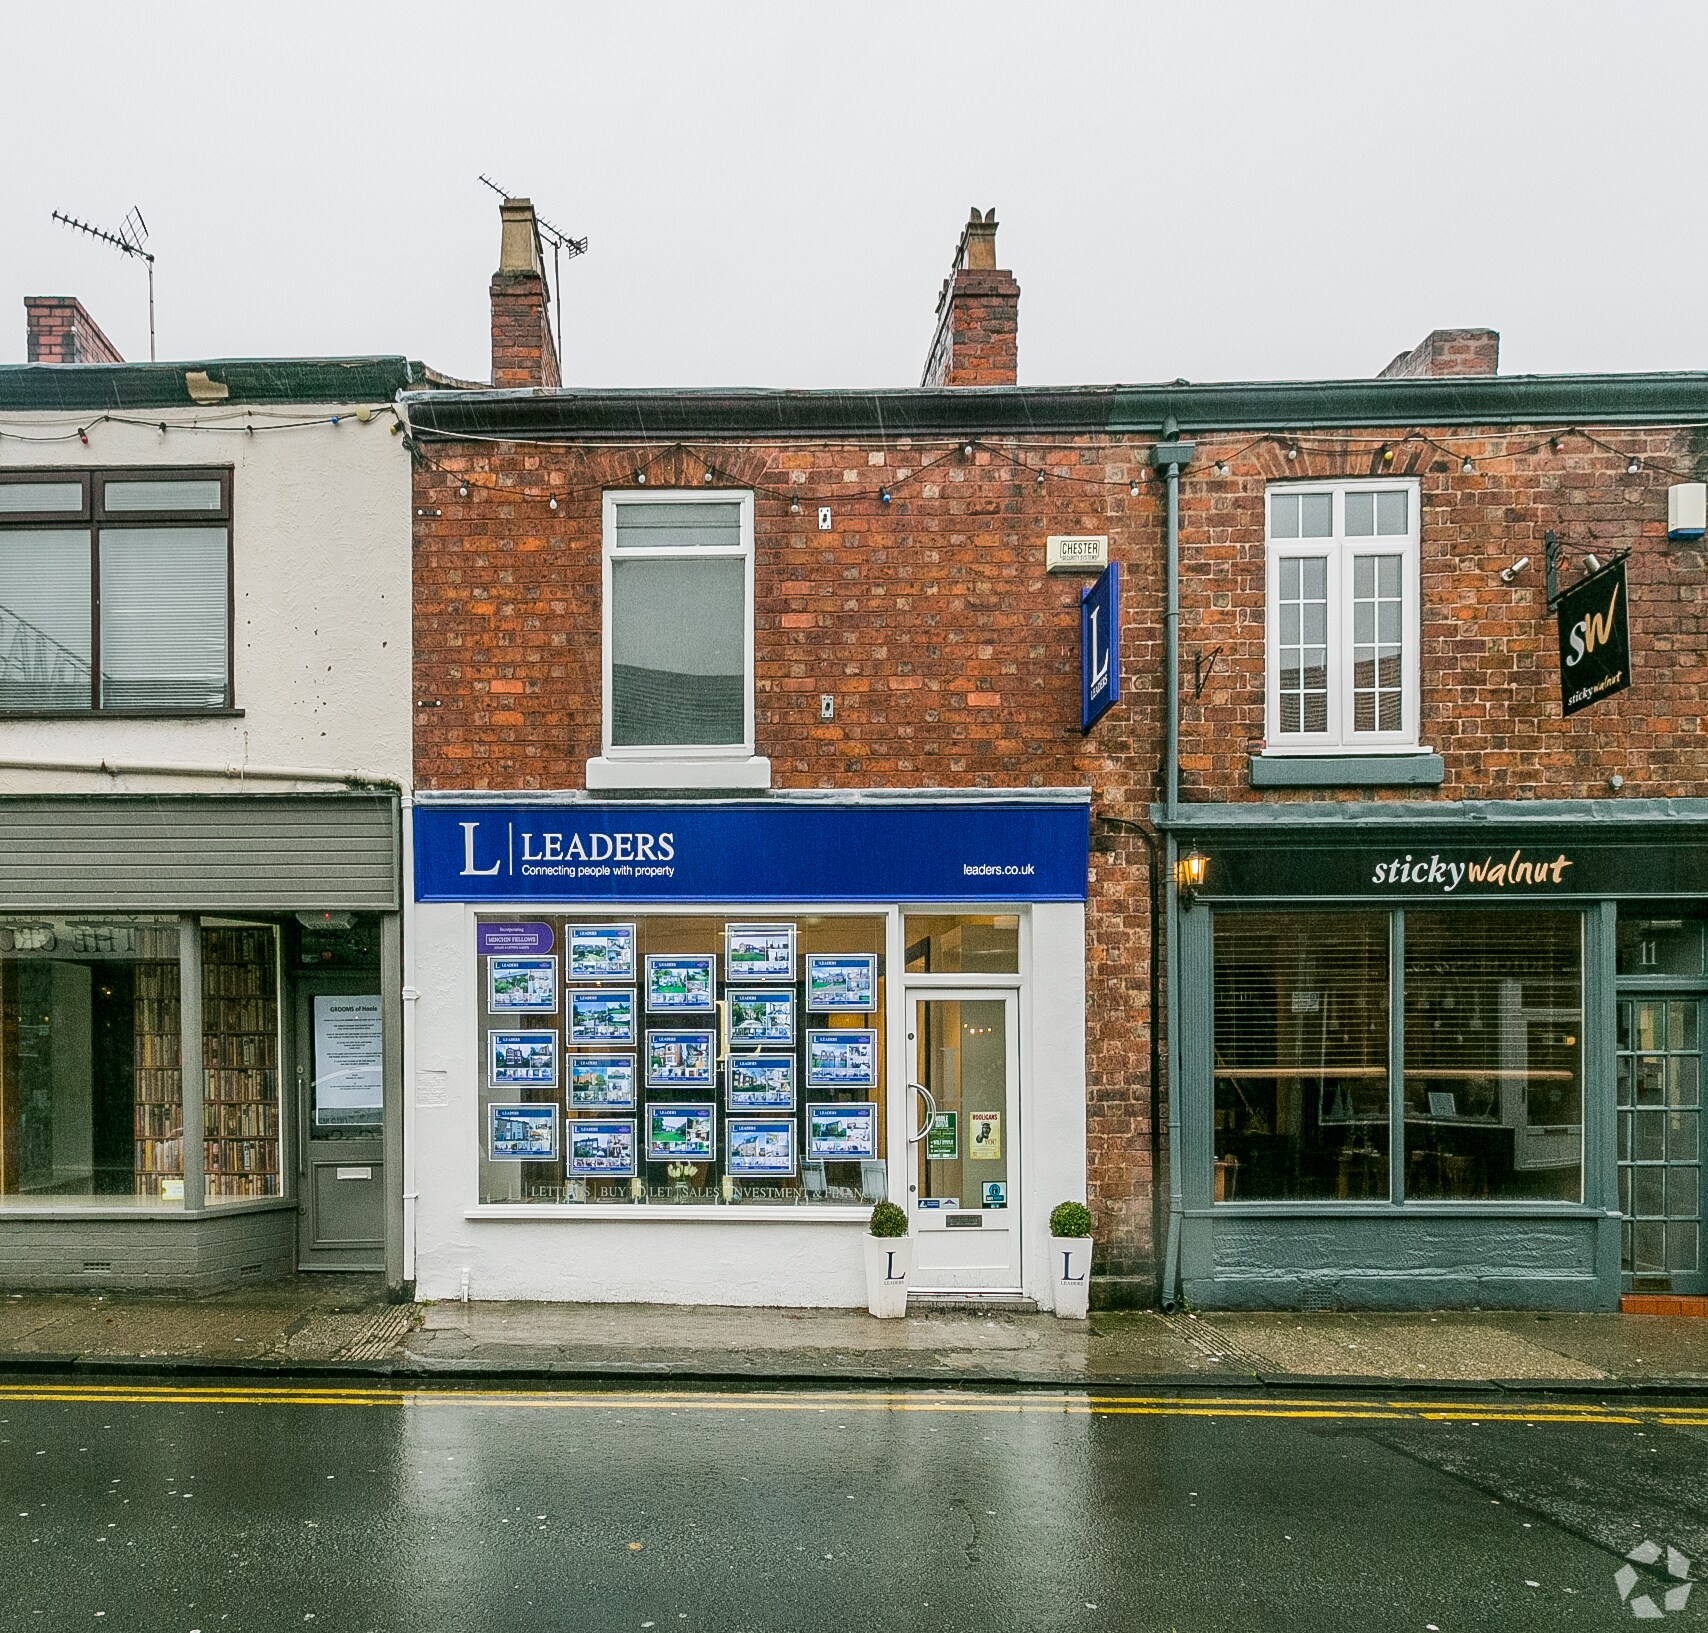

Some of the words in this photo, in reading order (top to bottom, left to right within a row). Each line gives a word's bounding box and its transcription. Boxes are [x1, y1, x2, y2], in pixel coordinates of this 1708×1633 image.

[1062, 542, 1098, 554] CHESTER
[1090, 605, 1109, 688] L
[1090, 674, 1108, 701] LEADERS
[459, 822, 501, 876] L
[521, 833, 675, 861] LEADERS
[521, 864, 576, 877] Connecting
[577, 864, 611, 877] people
[612, 864, 633, 876] with
[634, 864, 675, 877] property
[963, 863, 1035, 875] leaders.co.uk
[1639, 941, 1658, 965] 11
[531, 1185, 591, 1197] LETTIS
[600, 1186, 627, 1197] BUY
[649, 1186, 673, 1198] LET
[682, 1186, 720, 1198] SALES
[730, 1186, 809, 1198] NVESTMENT
[812, 1188, 823, 1198] &
[884, 1251, 906, 1280] L
[1061, 1251, 1085, 1281] L
